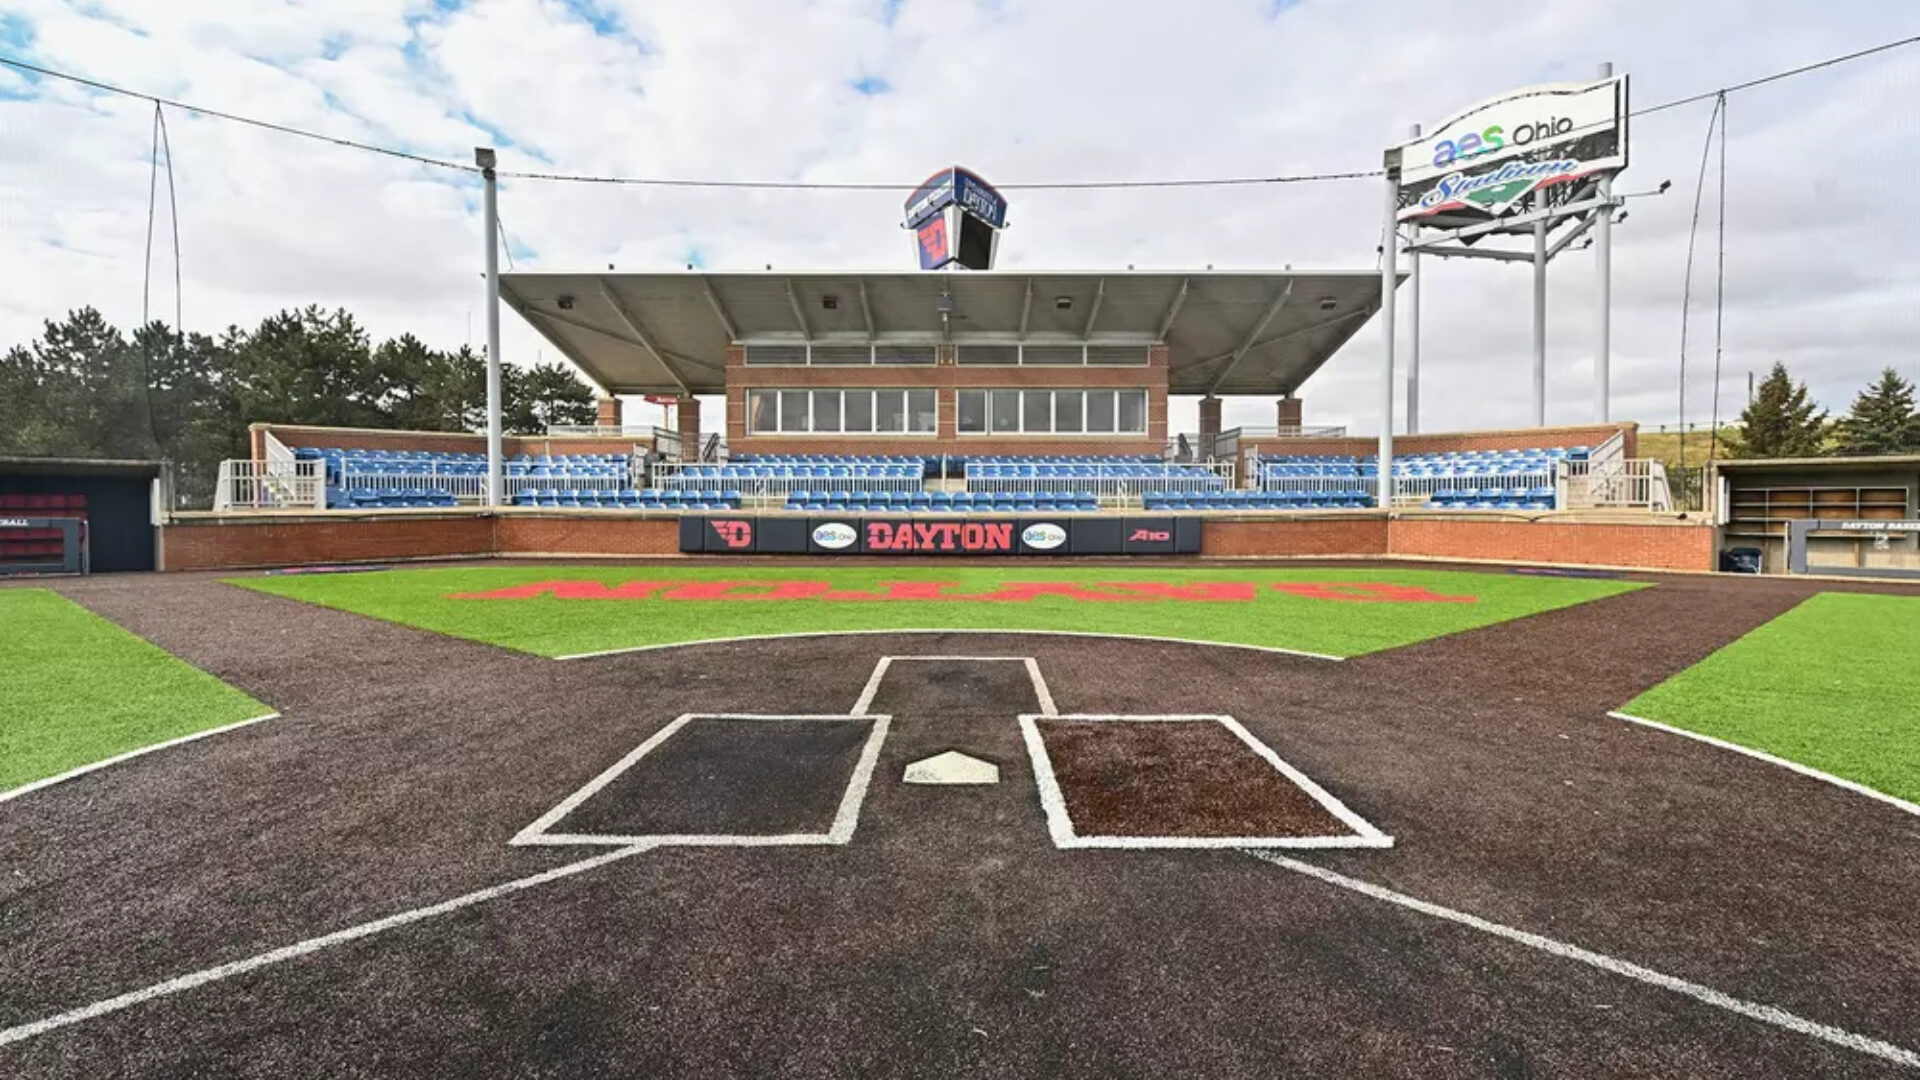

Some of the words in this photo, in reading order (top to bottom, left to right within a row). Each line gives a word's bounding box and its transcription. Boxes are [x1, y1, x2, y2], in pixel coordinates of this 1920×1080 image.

[1433, 125, 1504, 168] aes
[1512, 116, 1574, 146] Ohio
[1420, 158, 1579, 208] Stadium
[815, 530, 837, 541] aes
[867, 522, 1013, 549] DAYTON
[1025, 530, 1046, 541] aes
[1128, 529, 1170, 542] A10
[443, 580, 1478, 602] DAYTON
